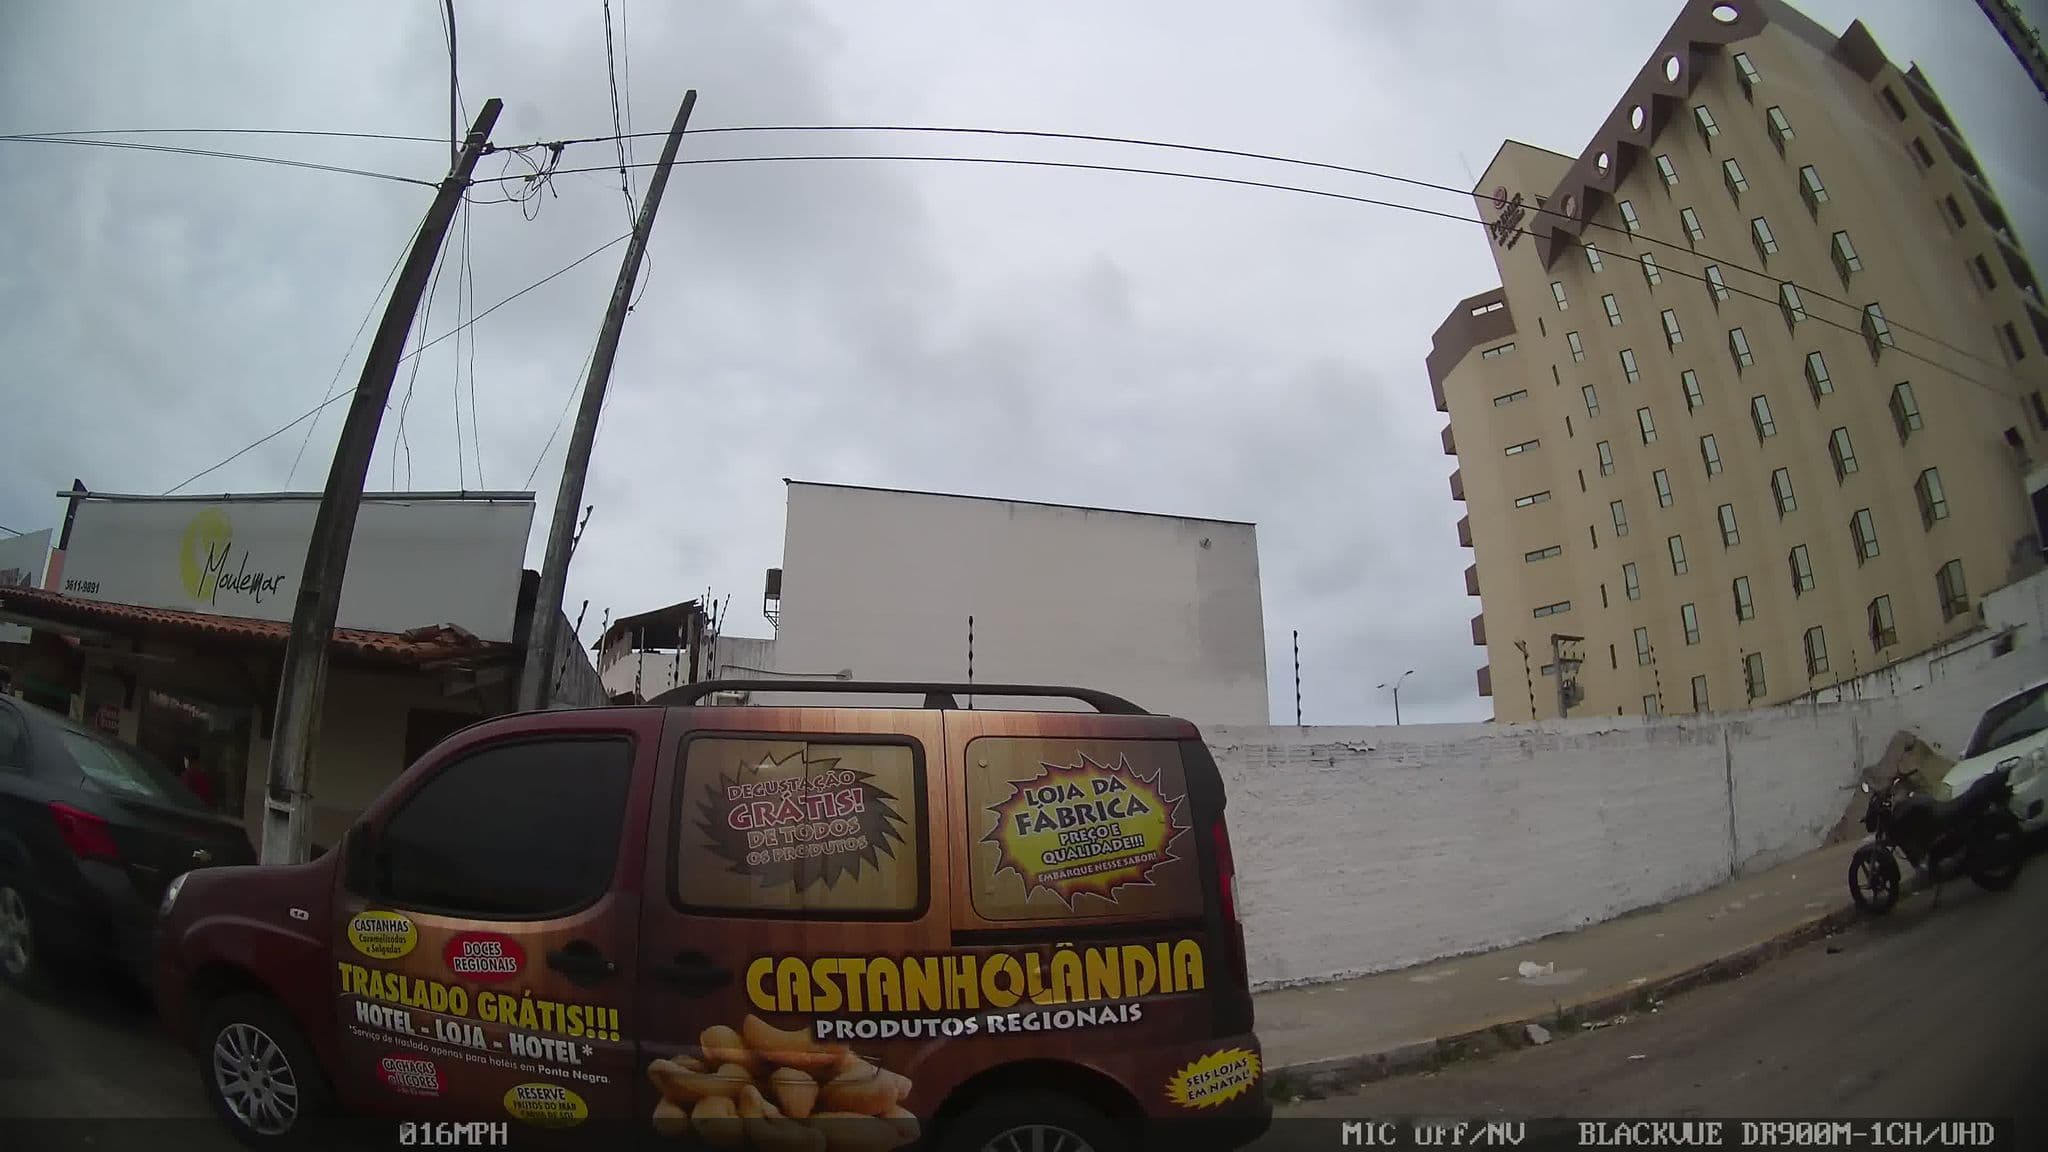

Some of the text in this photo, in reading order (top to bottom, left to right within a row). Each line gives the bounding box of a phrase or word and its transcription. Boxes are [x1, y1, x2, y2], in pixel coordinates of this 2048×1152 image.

[197, 542, 285, 606] Moulemar
[727, 770, 856, 801] DEGUSTAÇÃO
[1023, 774, 1127, 807] LOJA DA
[728, 787, 865, 830] GRÁTIS!
[1014, 794, 1150, 836] FÁBRICA
[747, 816, 861, 849] DE TODOS
[1059, 823, 1121, 845] PREÇO E
[746, 836, 868, 866] OS PRODUTOS
[1042, 833, 1145, 865] QUALIDADE!!!
[1038, 852, 1157, 883] EMBARQUE NESSE SABOR!
[353, 918, 410, 933] CASTANHAS
[454, 957, 517, 973] REGIONAIS
[463, 941, 502, 957] DOCES
[746, 939, 1206, 1012] CASTANHOLÂNDIA
[338, 962, 620, 1042] TRASLADO GRÁTIS!!!
[356, 1000, 415, 1035] HOTEL
[435, 1019, 487, 1050] LOJA
[816, 1003, 1143, 1039] PRODUTOS REGIONAIS
[382, 1032, 393, 1043] de
[394, 1036, 430, 1052] traslado
[465, 1054, 487, 1066] para
[520, 1063, 536, 1073] em
[538, 1065, 570, 1079] Ponta
[1186, 1057, 1248, 1087] SEIS LOJAS
[517, 1087, 566, 1100] RESERVE
[1188, 1088, 1207, 1100] EM
